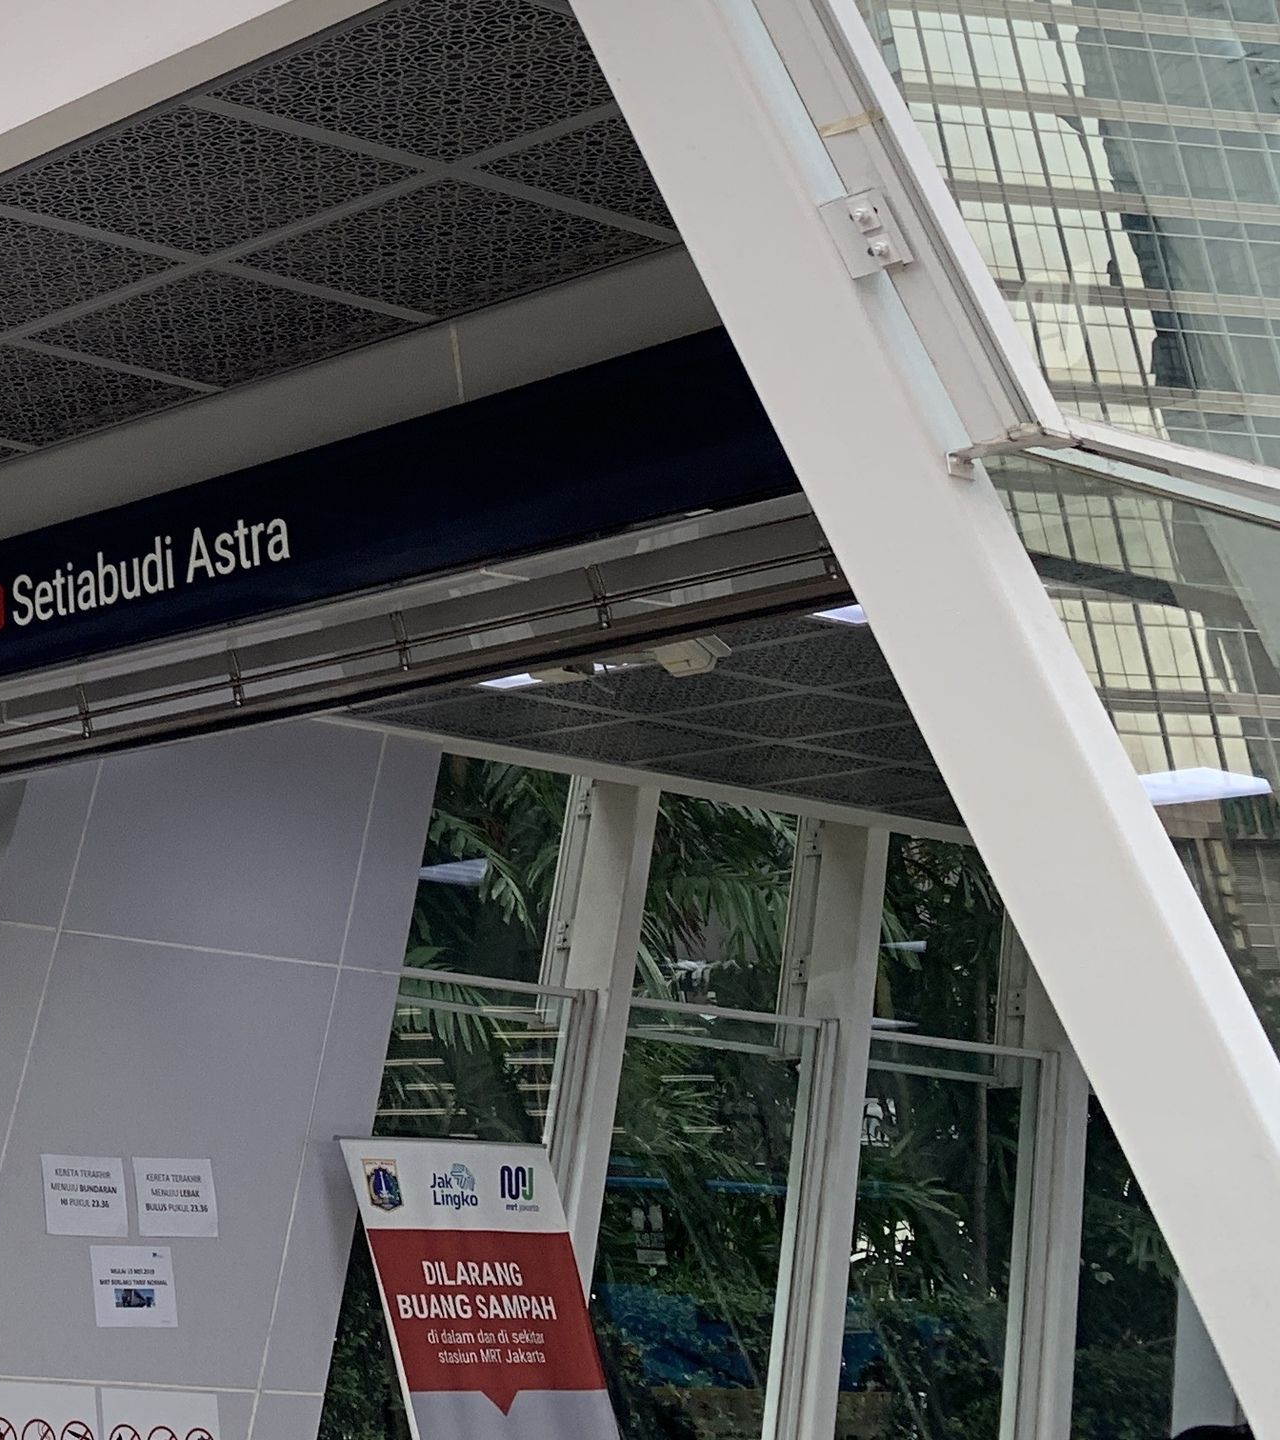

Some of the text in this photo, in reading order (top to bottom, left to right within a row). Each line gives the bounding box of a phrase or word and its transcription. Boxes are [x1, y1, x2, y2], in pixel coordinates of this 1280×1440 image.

[12, 518, 291, 627] Setiabudi Astra
[54, 1168, 112, 1179] KERETA TERAKHIR
[146, 1173, 202, 1183] KERETA TERAKHIR
[430, 1172, 453, 1189] Jak
[50, 1182, 117, 1194] MENUJU BUNDARAN
[151, 1188, 200, 1198] MENUJU LEBAK
[60, 1198, 68, 1206] HI
[69, 1198, 91, 1208] PUKUL
[433, 1189, 479, 1210] Lingko
[145, 1203, 168, 1212] BULUS
[168, 1204, 190, 1213] PUKUL
[422, 1260, 523, 1287] DILARANG
[396, 1294, 558, 1320] BUANG SAMPAH
[427, 1329, 544, 1344] di dalam dan di sekitar
[438, 1349, 546, 1364] stasiun MRT Jakarta
